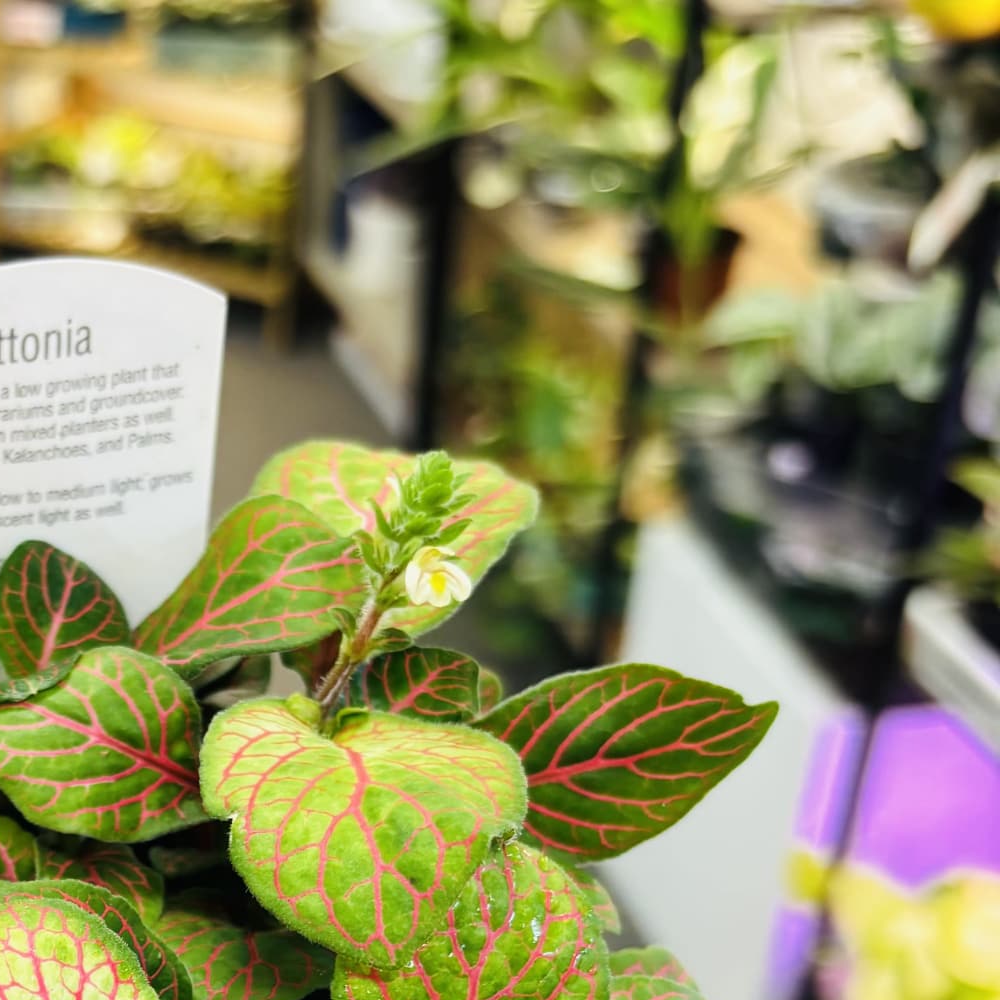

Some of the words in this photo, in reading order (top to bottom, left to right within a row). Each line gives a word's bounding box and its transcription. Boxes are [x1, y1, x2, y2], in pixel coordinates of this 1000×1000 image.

[0, 386, 10, 400] a
[14, 382, 42, 398] low
[46, 374, 106, 398] growing
[111, 368, 147, 390] plant
[151, 361, 180, 380] that
[58, 396, 86, 415] and
[10, 423, 57, 443] mixed
[59, 417, 120, 441] planters
[122, 415, 141, 429] as
[96, 434, 124, 455] and
[26, 488, 42, 505] to
[46, 483, 105, 502] medium
[149, 471, 193, 492] grows
[38, 507, 71, 527] light
[74, 508, 91, 521] as
